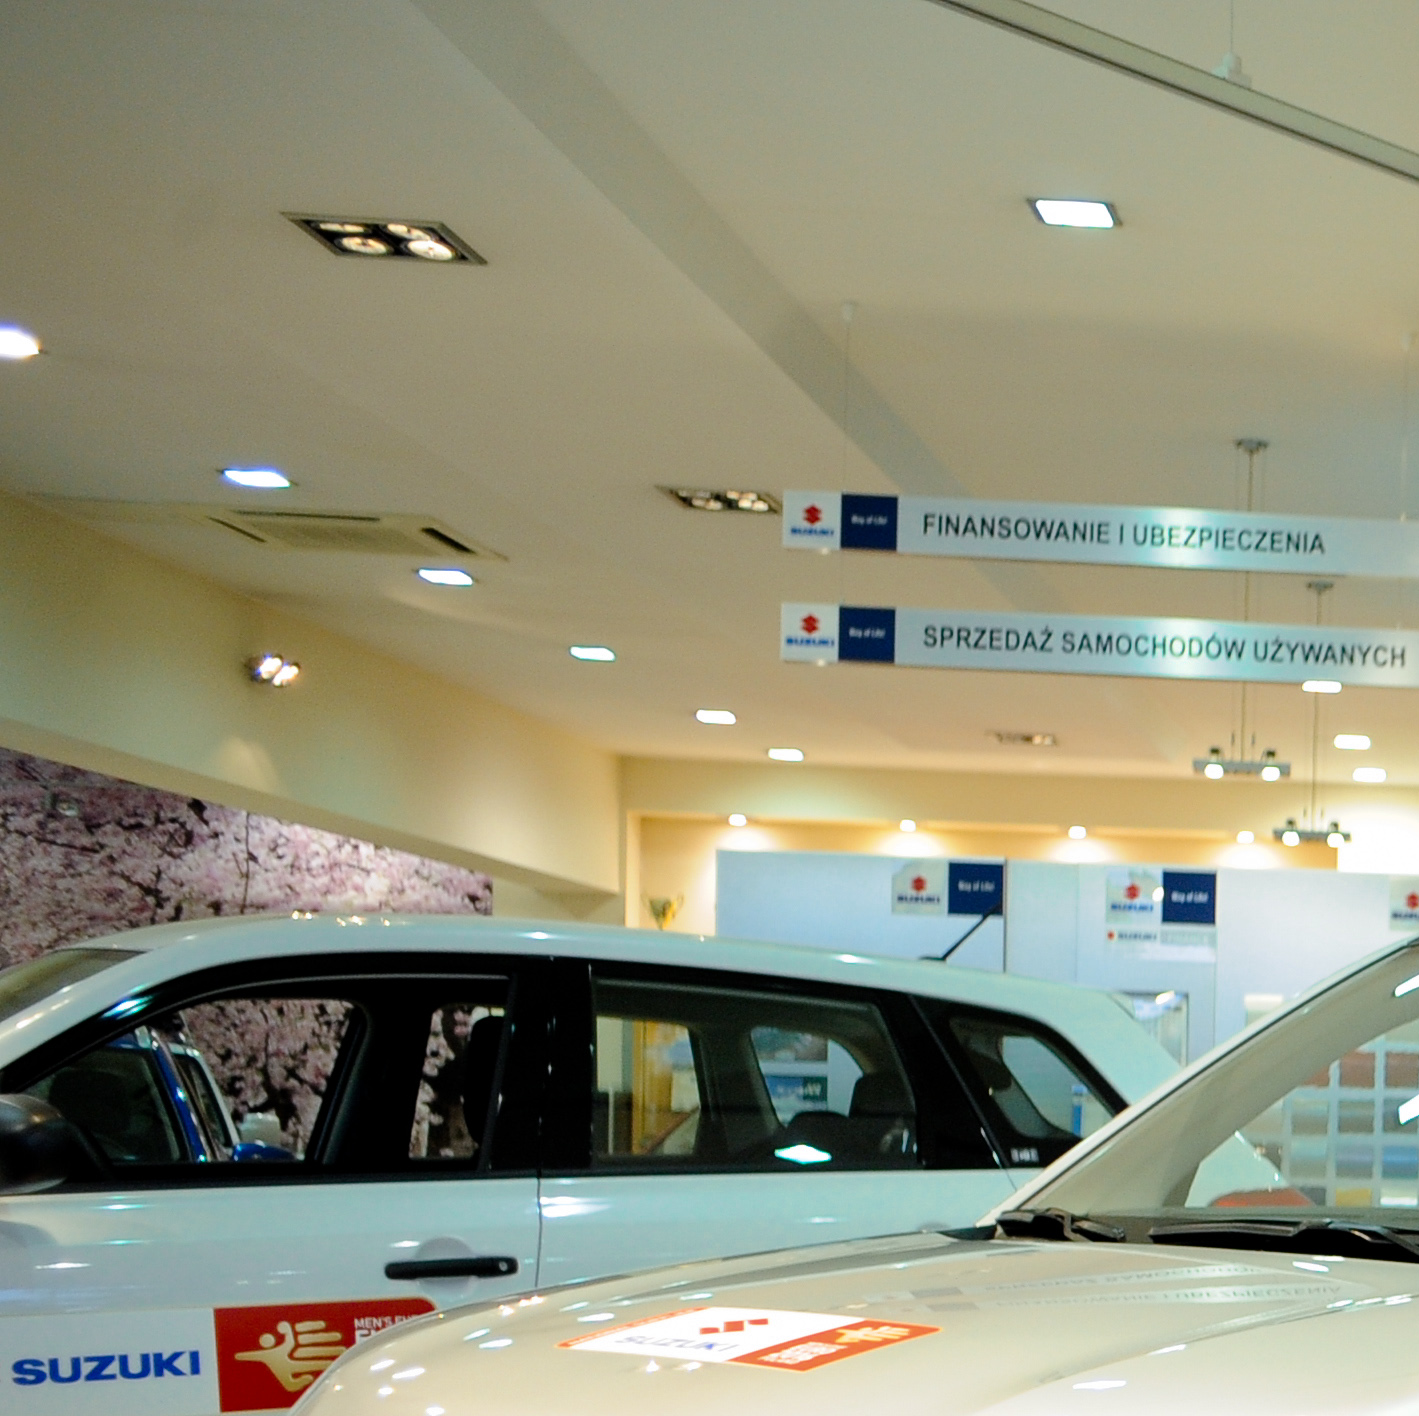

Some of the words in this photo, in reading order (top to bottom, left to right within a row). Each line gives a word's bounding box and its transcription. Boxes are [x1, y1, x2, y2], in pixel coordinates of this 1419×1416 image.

[923, 513, 1111, 544] FINANSOWANIE
[1119, 524, 1124, 544] I
[1132, 523, 1326, 554] UBEZPIECZENIA
[923, 625, 1053, 653] SPRZEDAŻ
[1062, 631, 1246, 661] SAMOCHODÓW
[1253, 635, 1406, 668] UŻYWANYCH
[615, 1334, 740, 1353] SUZUKI
[12, 1350, 201, 1386] SUZUKI
